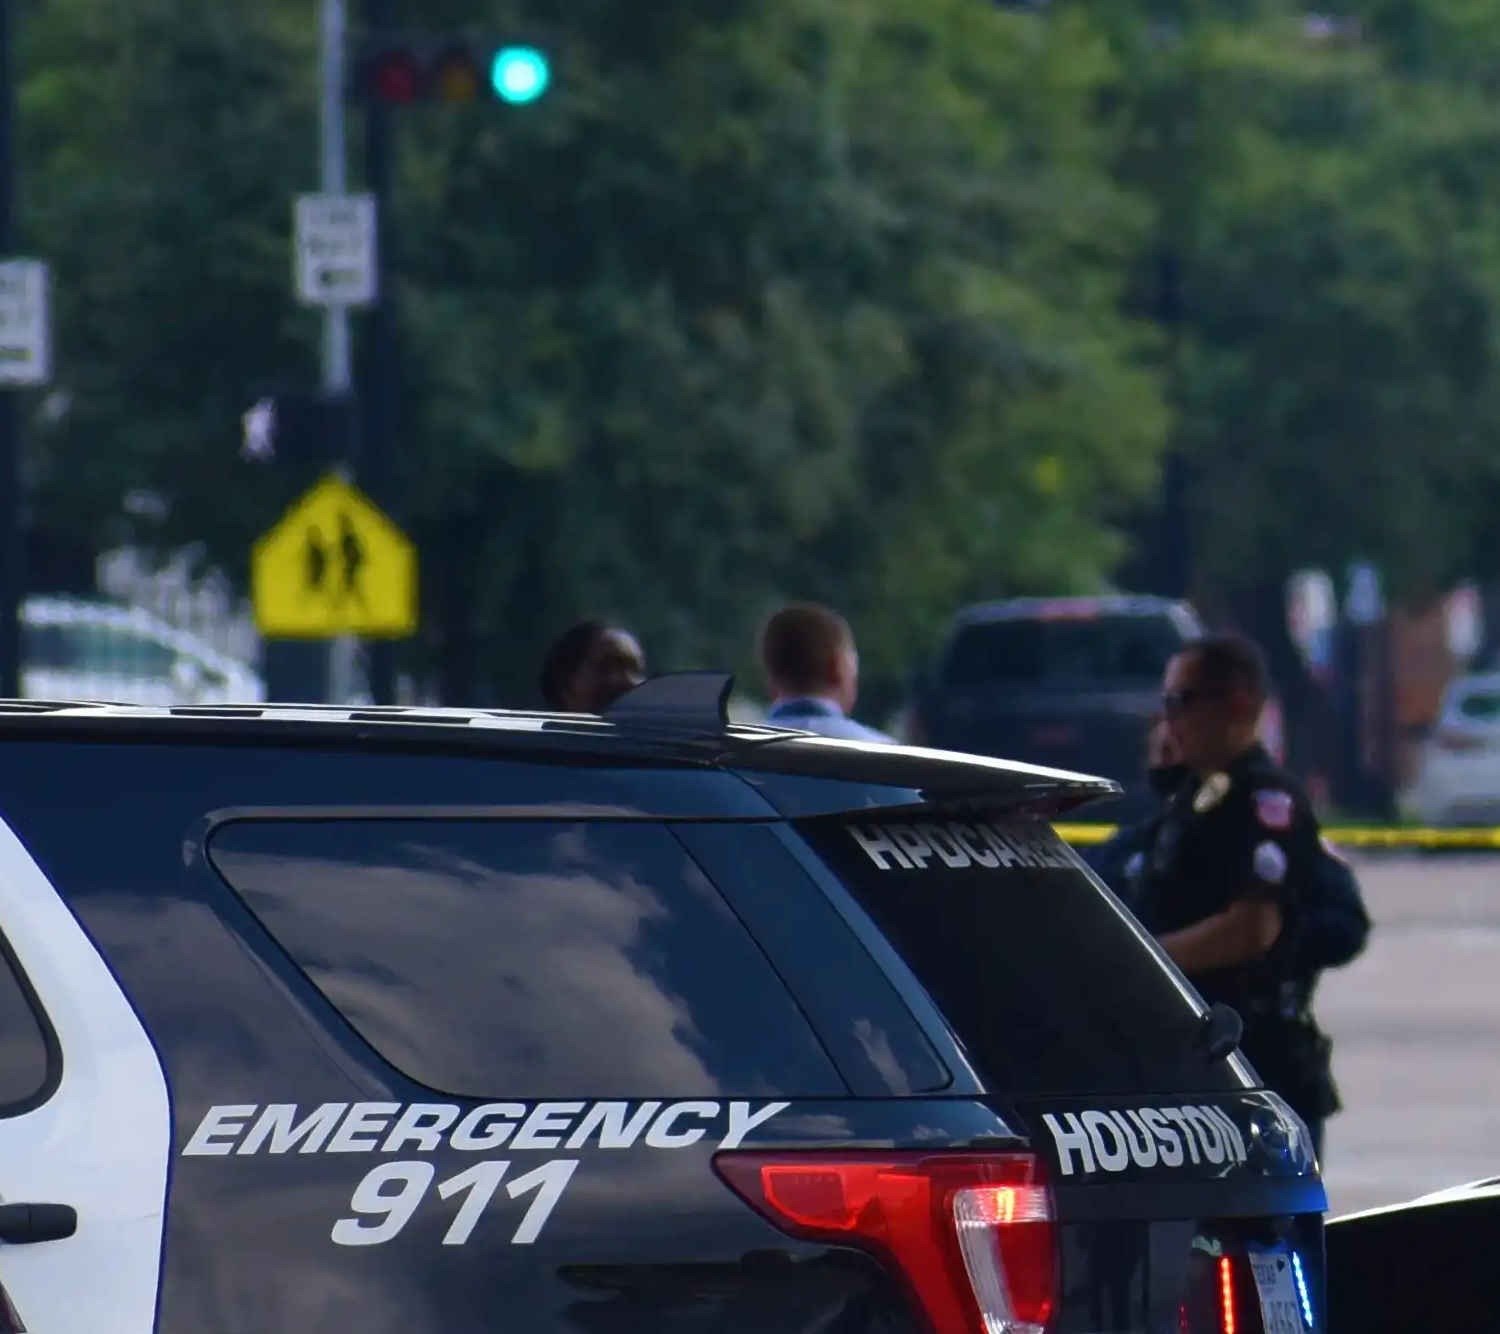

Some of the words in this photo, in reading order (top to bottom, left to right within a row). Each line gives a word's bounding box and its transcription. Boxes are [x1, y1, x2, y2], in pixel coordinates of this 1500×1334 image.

[182, 1101, 792, 1156] EMERGENCY
[1042, 1105, 1247, 1176] HOUSTON
[331, 1159, 580, 1246] 911
